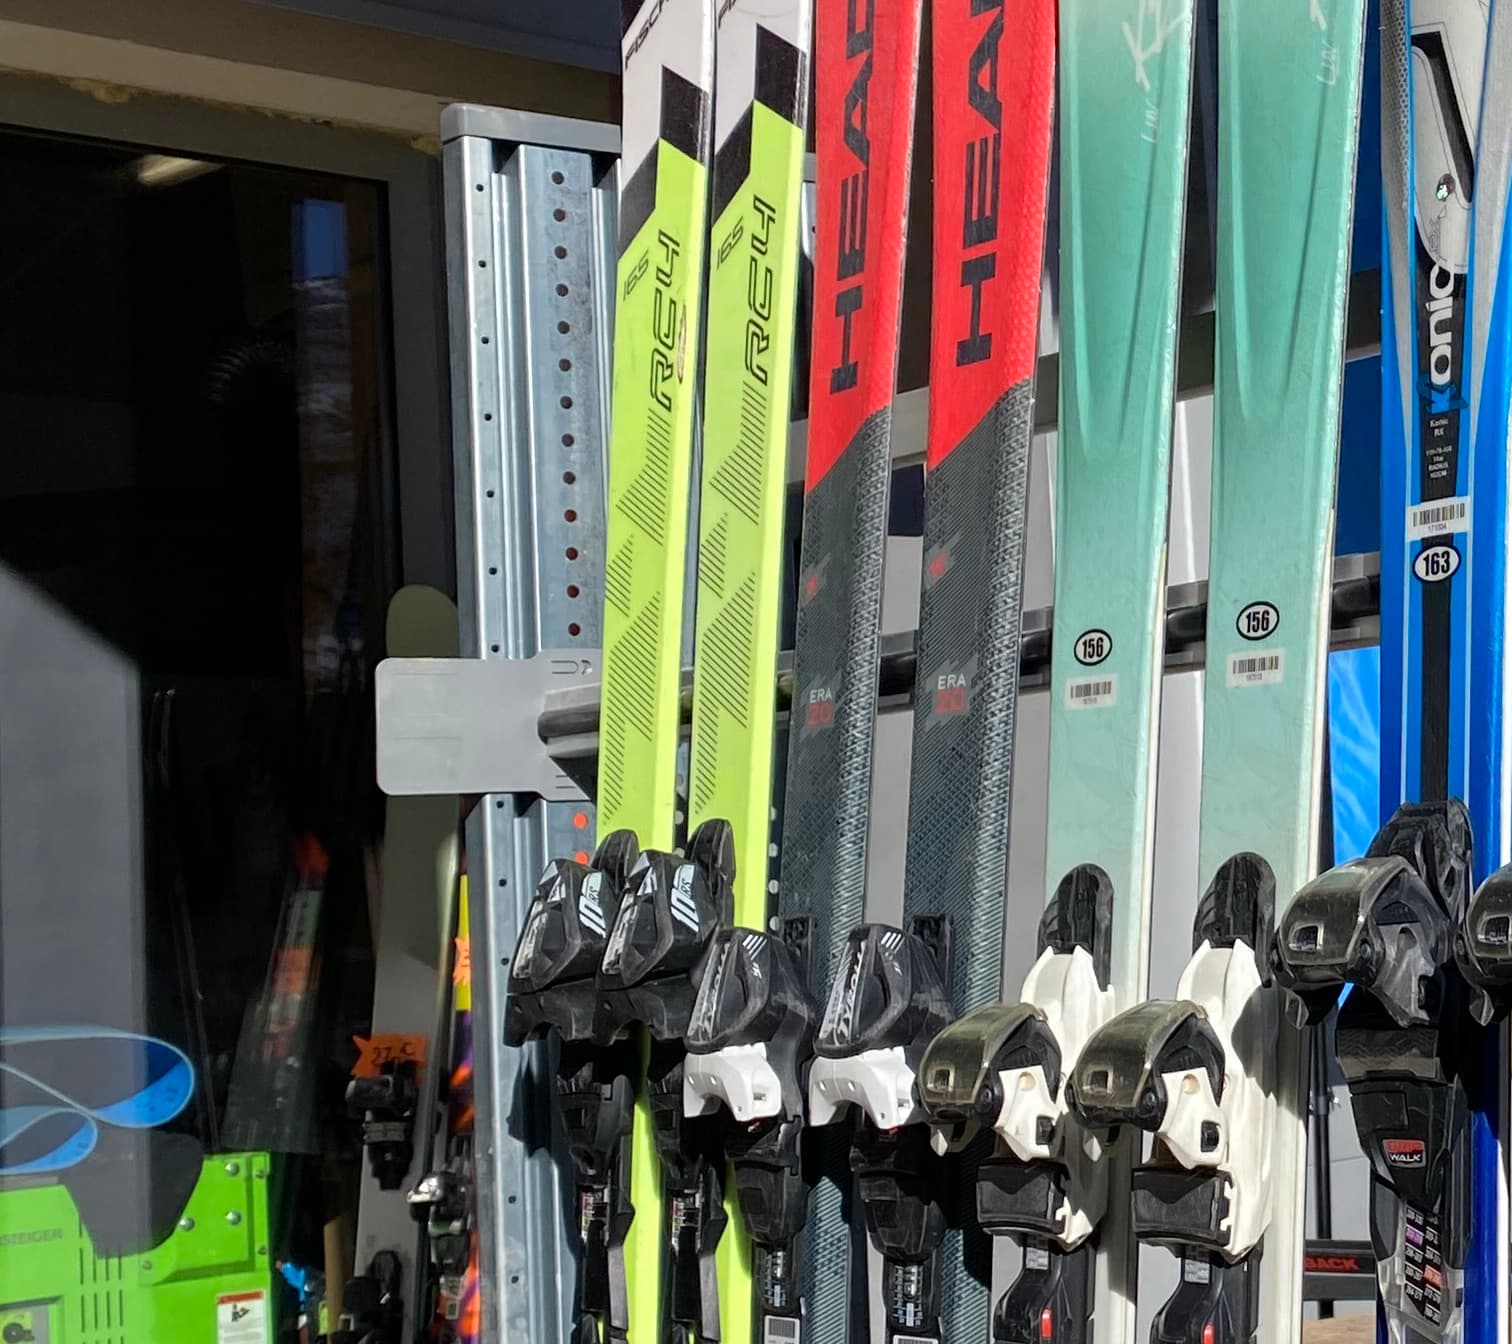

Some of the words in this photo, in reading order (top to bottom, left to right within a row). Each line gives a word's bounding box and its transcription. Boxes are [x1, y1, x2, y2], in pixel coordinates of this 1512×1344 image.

[716, 216, 744, 270] 165
[623, 249, 649, 301] 165
[745, 194, 776, 386] RC4
[650, 229, 680, 412] RC4
[1423, 552, 1450, 576] 163
[1246, 610, 1270, 633] 156
[1082, 637, 1104, 659] 156
[937, 673, 966, 689] ERA
[810, 688, 833, 703] ERA
[1389, 1153, 1421, 1162] WALK
